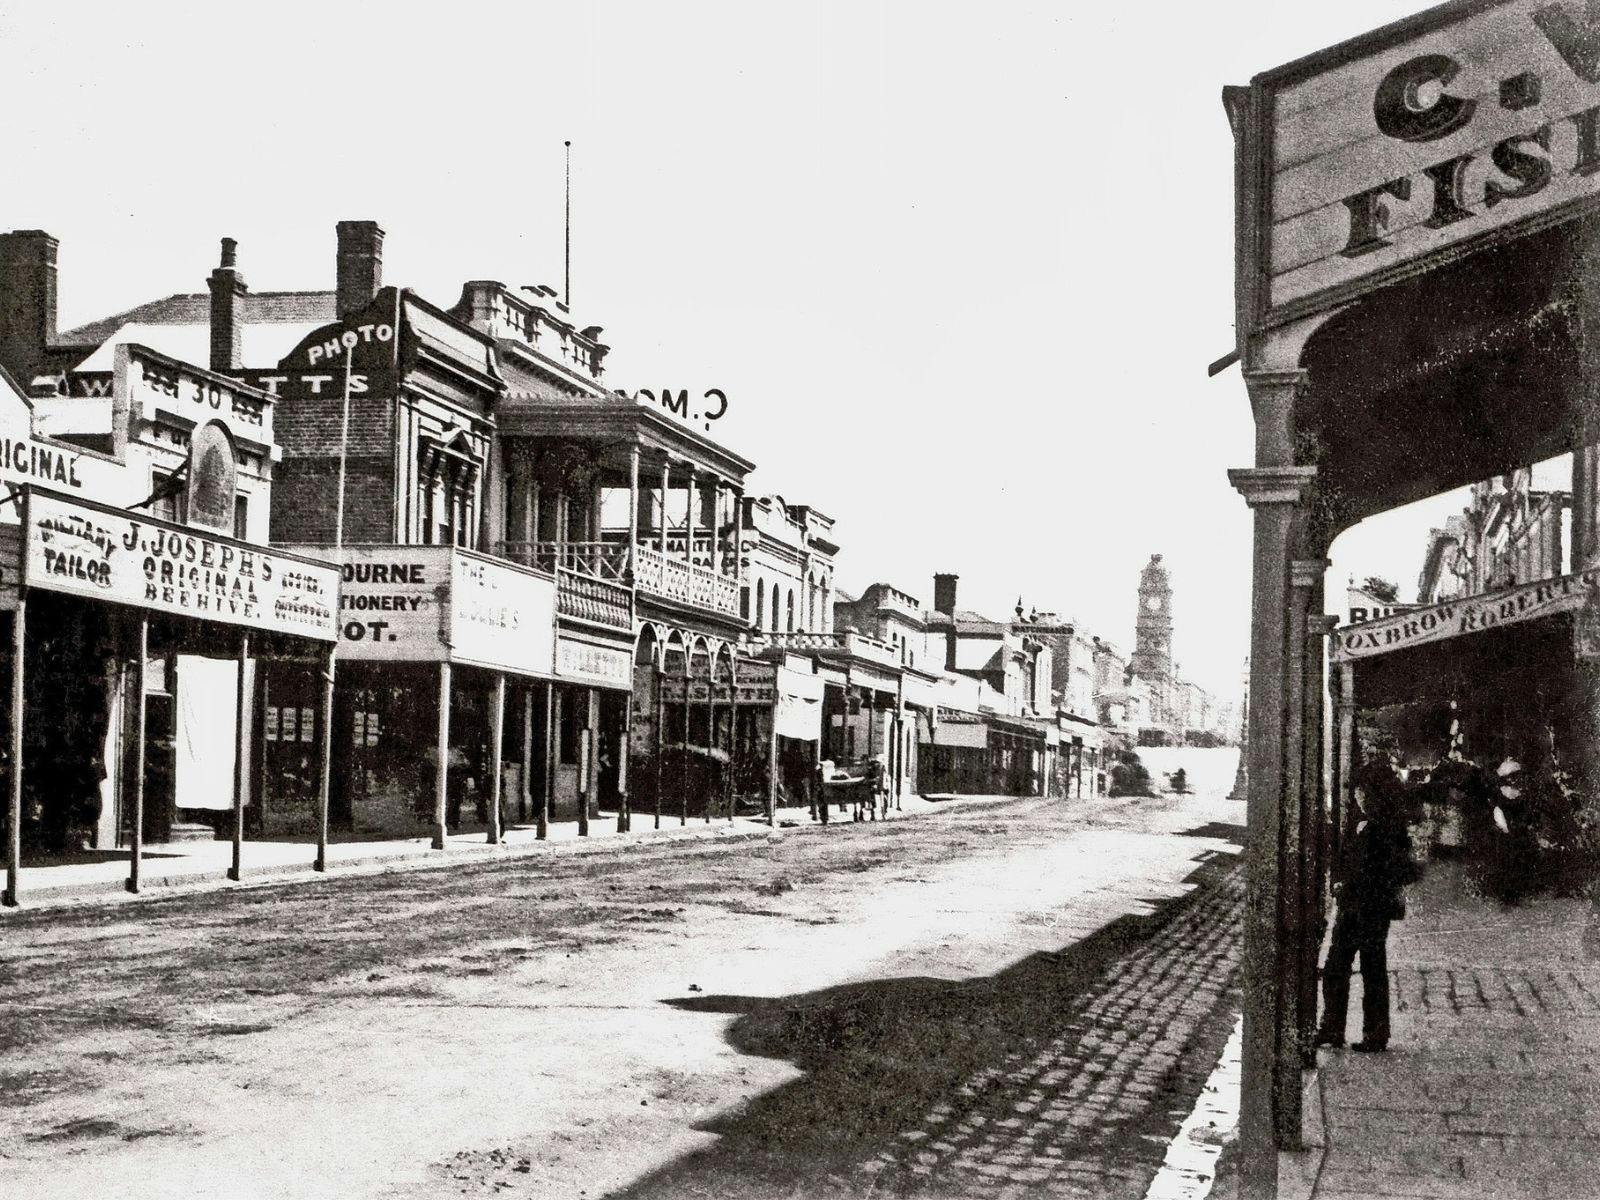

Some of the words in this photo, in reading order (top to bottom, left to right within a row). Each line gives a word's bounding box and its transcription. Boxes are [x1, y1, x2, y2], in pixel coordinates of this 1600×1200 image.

[308, 324, 393, 365] PHOTO
[0, 437, 82, 488] IGINAL
[44, 547, 112, 586] TAILOR
[142, 556, 258, 603] ORIGINAL
[339, 621, 397, 642] OT.
[1346, 606, 1454, 650] OXBROW
